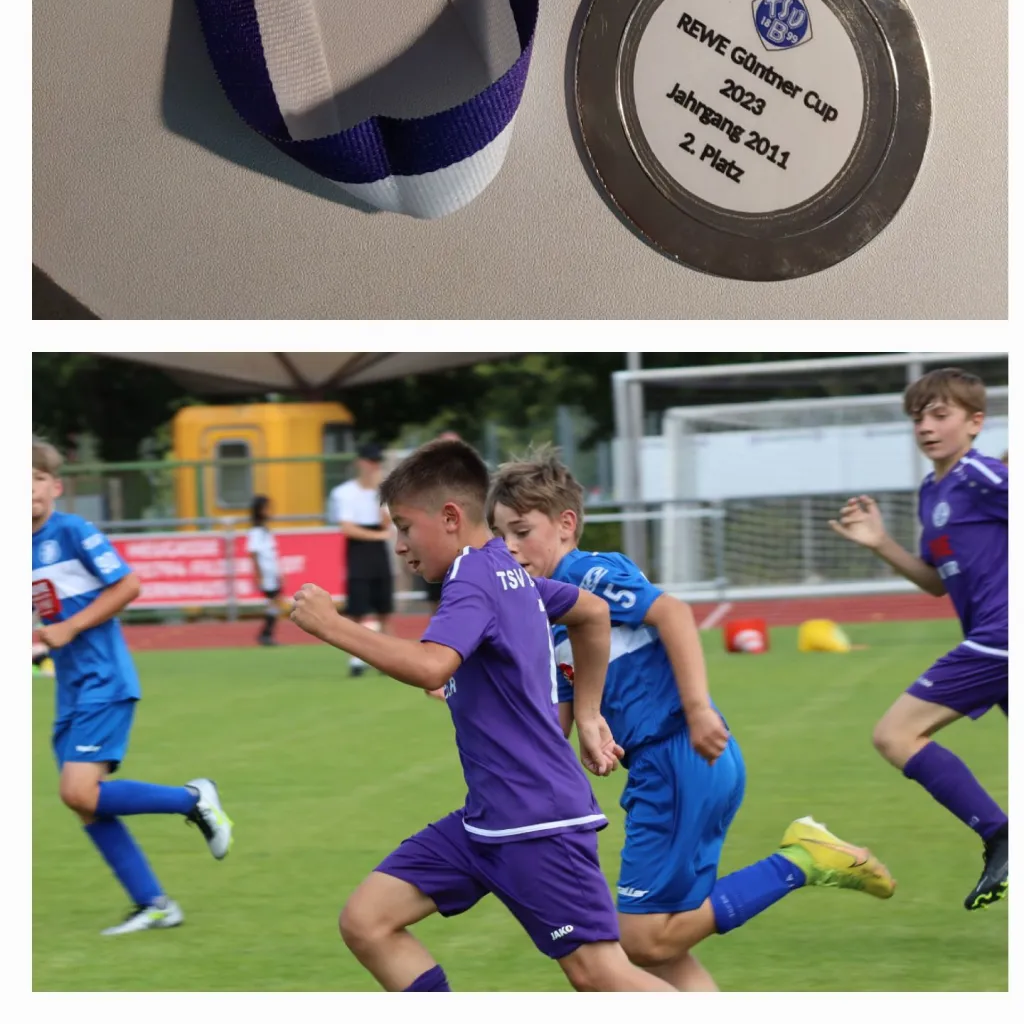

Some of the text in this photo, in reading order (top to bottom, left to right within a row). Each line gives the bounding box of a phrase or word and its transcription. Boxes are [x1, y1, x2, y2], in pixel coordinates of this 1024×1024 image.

[676, 12, 839, 123] REWE Güntner Cup
[719, 78, 767, 116] 2023
[667, 82, 791, 170] Jahrgang 2011
[678, 132, 745, 184] 2. Platz
[496, 567, 525, 590] TSV
[603, 583, 636, 609] 5
[550, 925, 574, 941] JAKO
